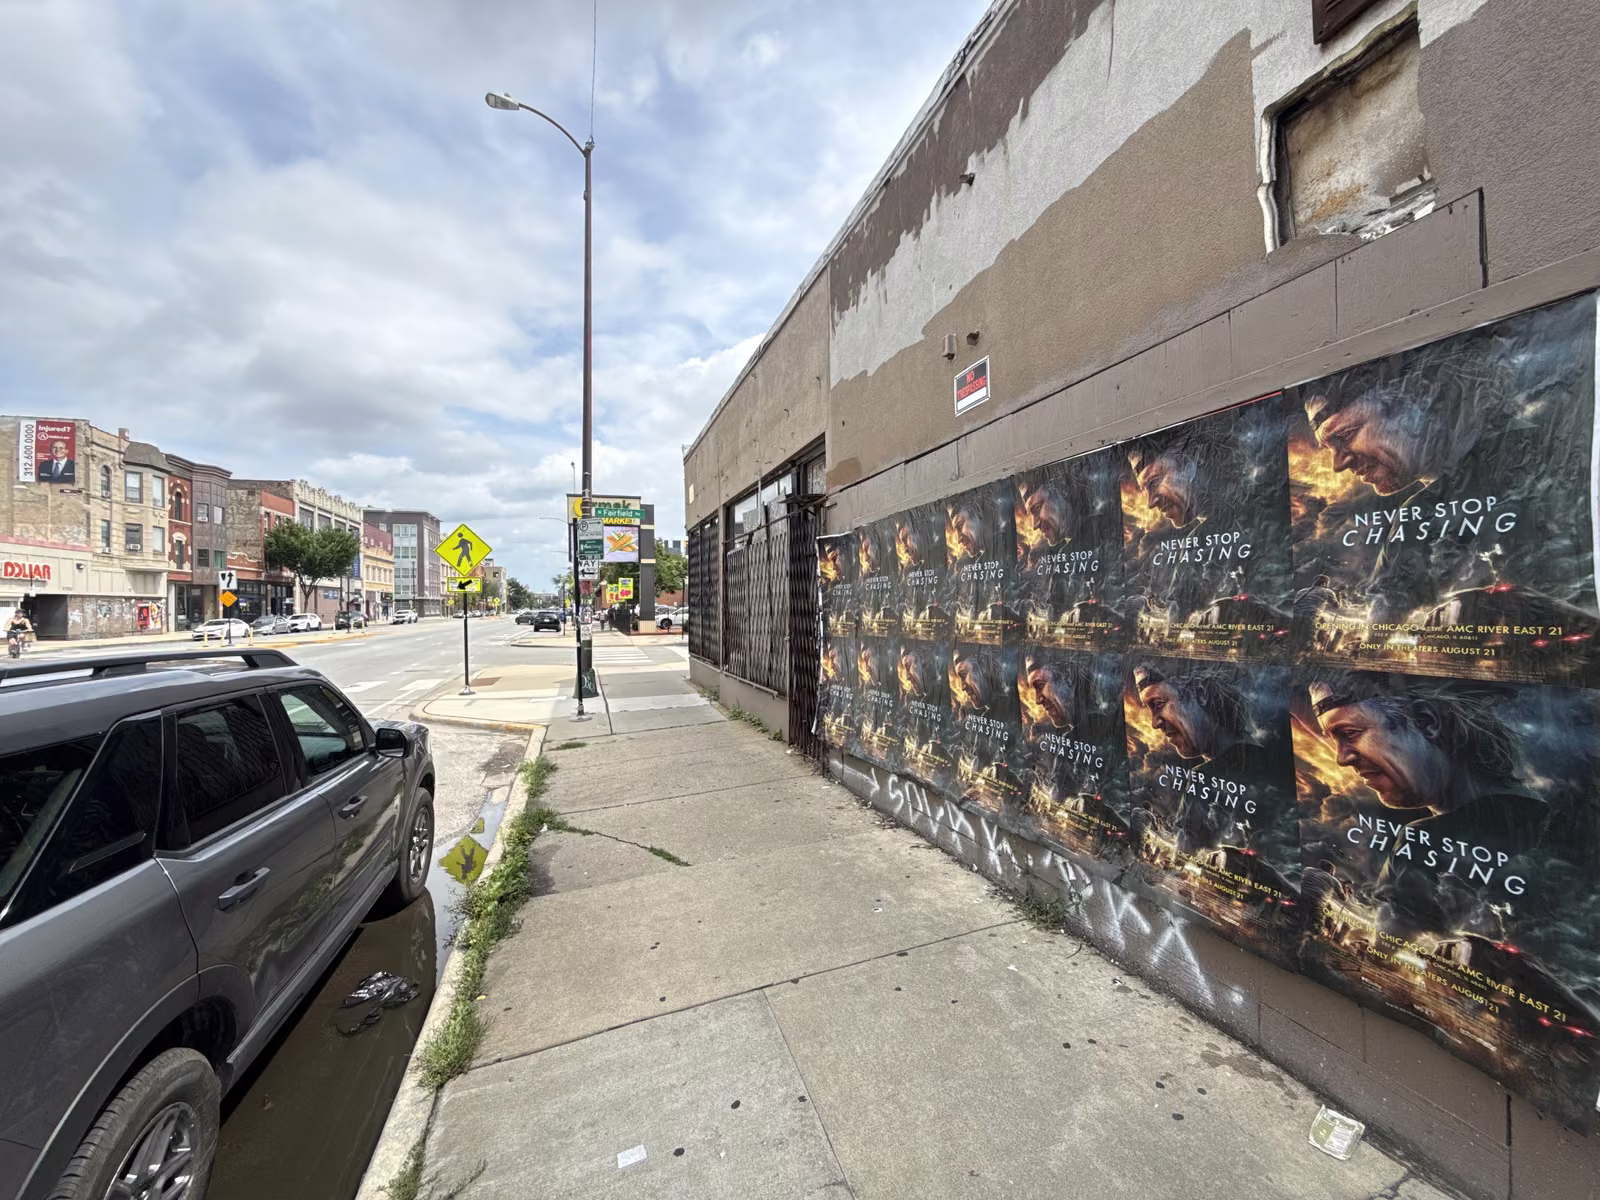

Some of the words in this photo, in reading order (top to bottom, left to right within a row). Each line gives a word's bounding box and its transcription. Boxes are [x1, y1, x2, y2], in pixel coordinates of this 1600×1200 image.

[966, 370, 975, 384] NO
[38, 425, 71, 433] Injured?
[23, 424, 34, 477] 312.600.0000
[603, 509, 633, 517] Fairfield
[1354, 506, 1423, 527] NEVER
[1434, 496, 1499, 518] STOP
[1342, 512, 1517, 547] CHASING
[1160, 536, 1199, 551] NEVER
[1205, 531, 1241, 546] STOP
[1041, 552, 1067, 564] NEVER
[1070, 550, 1093, 561] STOP
[1152, 544, 1251, 566] CHASING
[960, 569, 1004, 581] CHASING
[1036, 560, 1099, 576] CHASING
[1372, 623, 1419, 632] CHICAGO
[1446, 625, 1474, 633] AMC
[1478, 625, 1510, 634] RIVER
[1513, 626, 1544, 635] EAST
[1548, 626, 1563, 636] 21
[1359, 642, 1381, 650] ONLY
[1441, 646, 1481, 656] AUGUST
[1483, 648, 1496, 656] 21
[964, 721, 1009, 741] CHASING
[968, 714, 987, 725] NEVER
[990, 719, 1005, 729] STOP
[1044, 733, 1071, 749] NEVER
[1074, 739, 1097, 754] STOP
[1039, 741, 1104, 769] CHASING
[1165, 763, 1205, 785] NEVER
[1211, 776, 1246, 795] STOP
[1158, 774, 1257, 814] CHASING
[1358, 813, 1431, 846] NEVER
[1441, 837, 1509, 867] STOP
[1347, 827, 1526, 895] CHASING
[1234, 874, 1253, 886] RIVER
[1254, 881, 1272, 894] EAST
[1273, 889, 1282, 898] 21
[1366, 946, 1388, 960] ONLY
[1404, 963, 1448, 986] THEATERS
[1451, 983, 1488, 1006] AUGUST
[1488, 1003, 1500, 1013] 21
[1378, 931, 1429, 955] CHICAGO
[1457, 964, 1484, 982] AMC
[1486, 976, 1516, 998] RIVER
[1519, 992, 1550, 1013] EAST
[1553, 1008, 1567, 1022] 21
